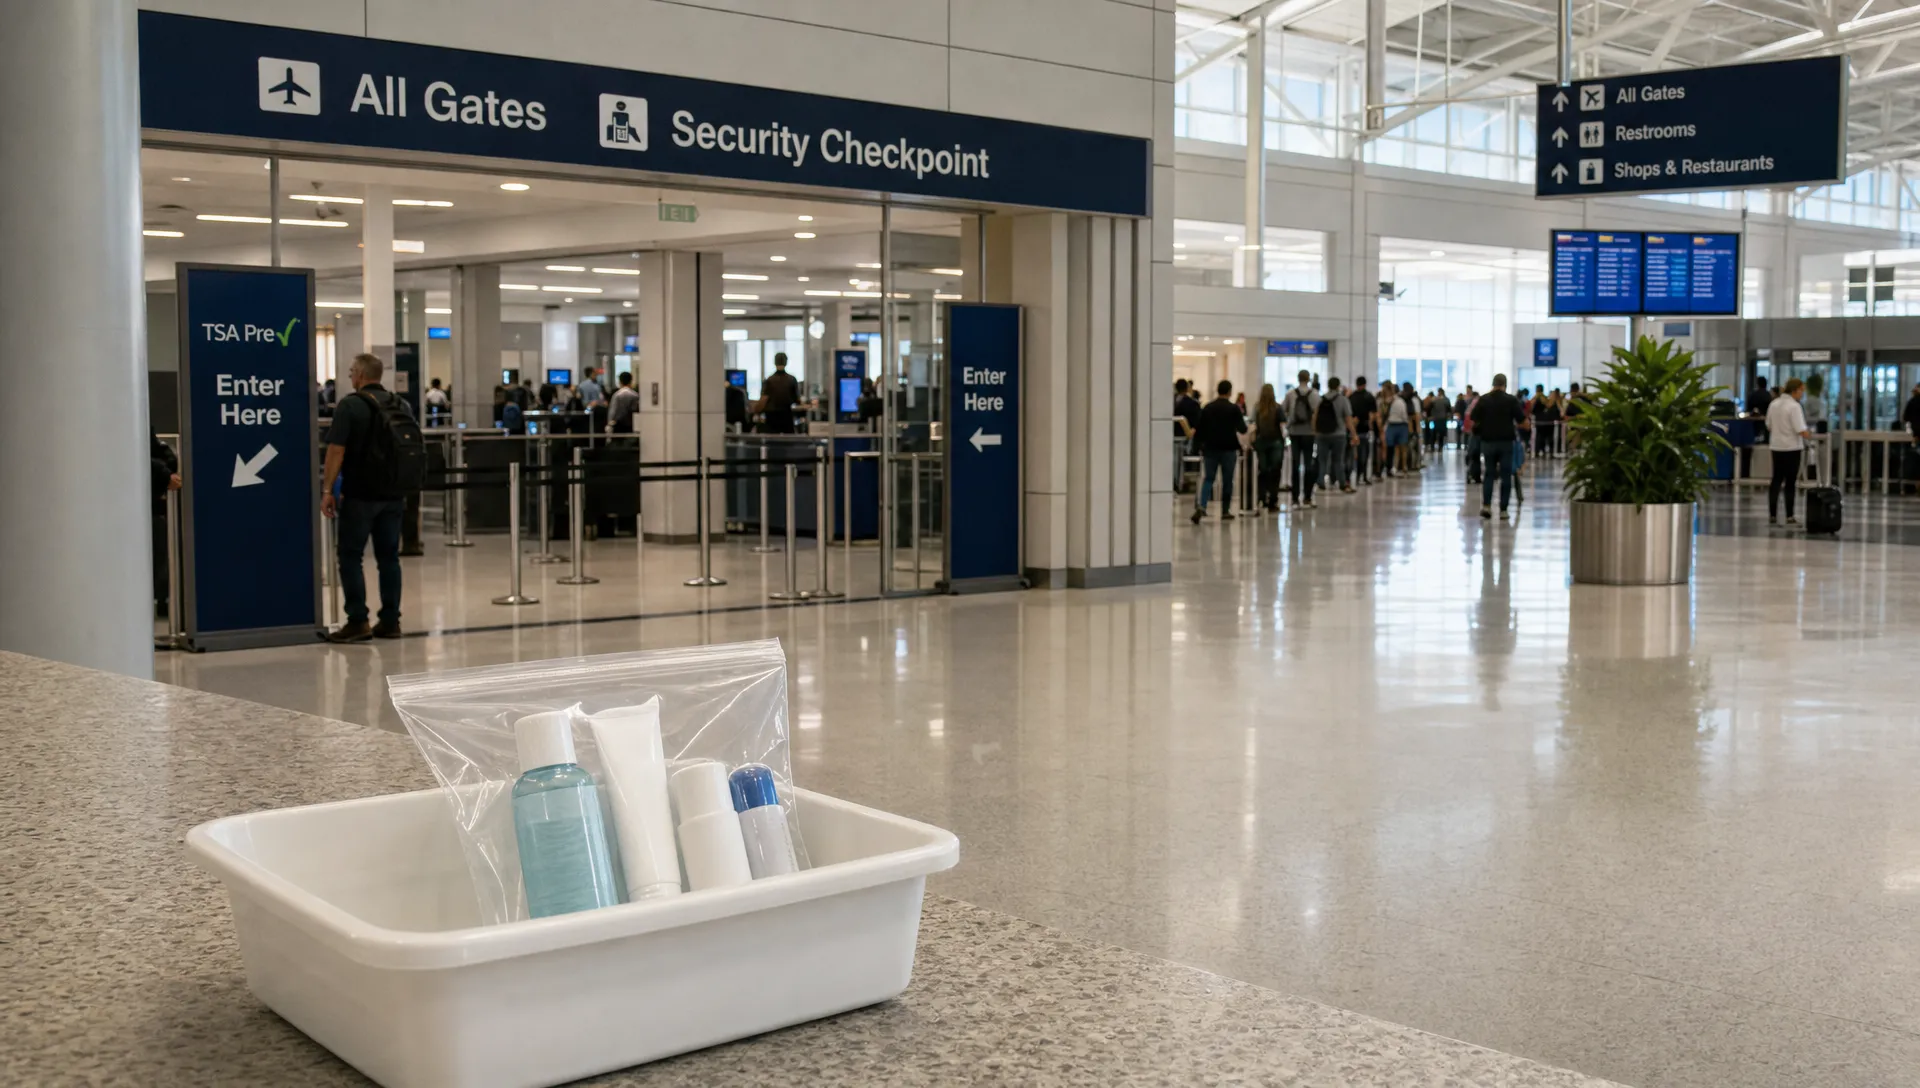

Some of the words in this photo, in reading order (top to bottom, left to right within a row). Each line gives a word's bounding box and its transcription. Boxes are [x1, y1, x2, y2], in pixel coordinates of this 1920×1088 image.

[351, 73, 407, 118] All
[424, 80, 547, 131] Gates
[1616, 86, 1636, 104] All
[1641, 85, 1686, 102] Gates
[1615, 124, 1697, 141] Restrooms
[672, 109, 810, 168] Security
[822, 128, 990, 181] Checkpoint
[1614, 161, 1661, 181] Shops
[1665, 160, 1677, 175] &
[1681, 155, 1774, 175] Restaurants
[201, 323, 240, 342] TSA
[244, 324, 275, 342] Pre
[216, 373, 285, 397] Enter
[963, 366, 1007, 385] Enter
[964, 392, 1004, 412] Here
[220, 403, 282, 426] Here
